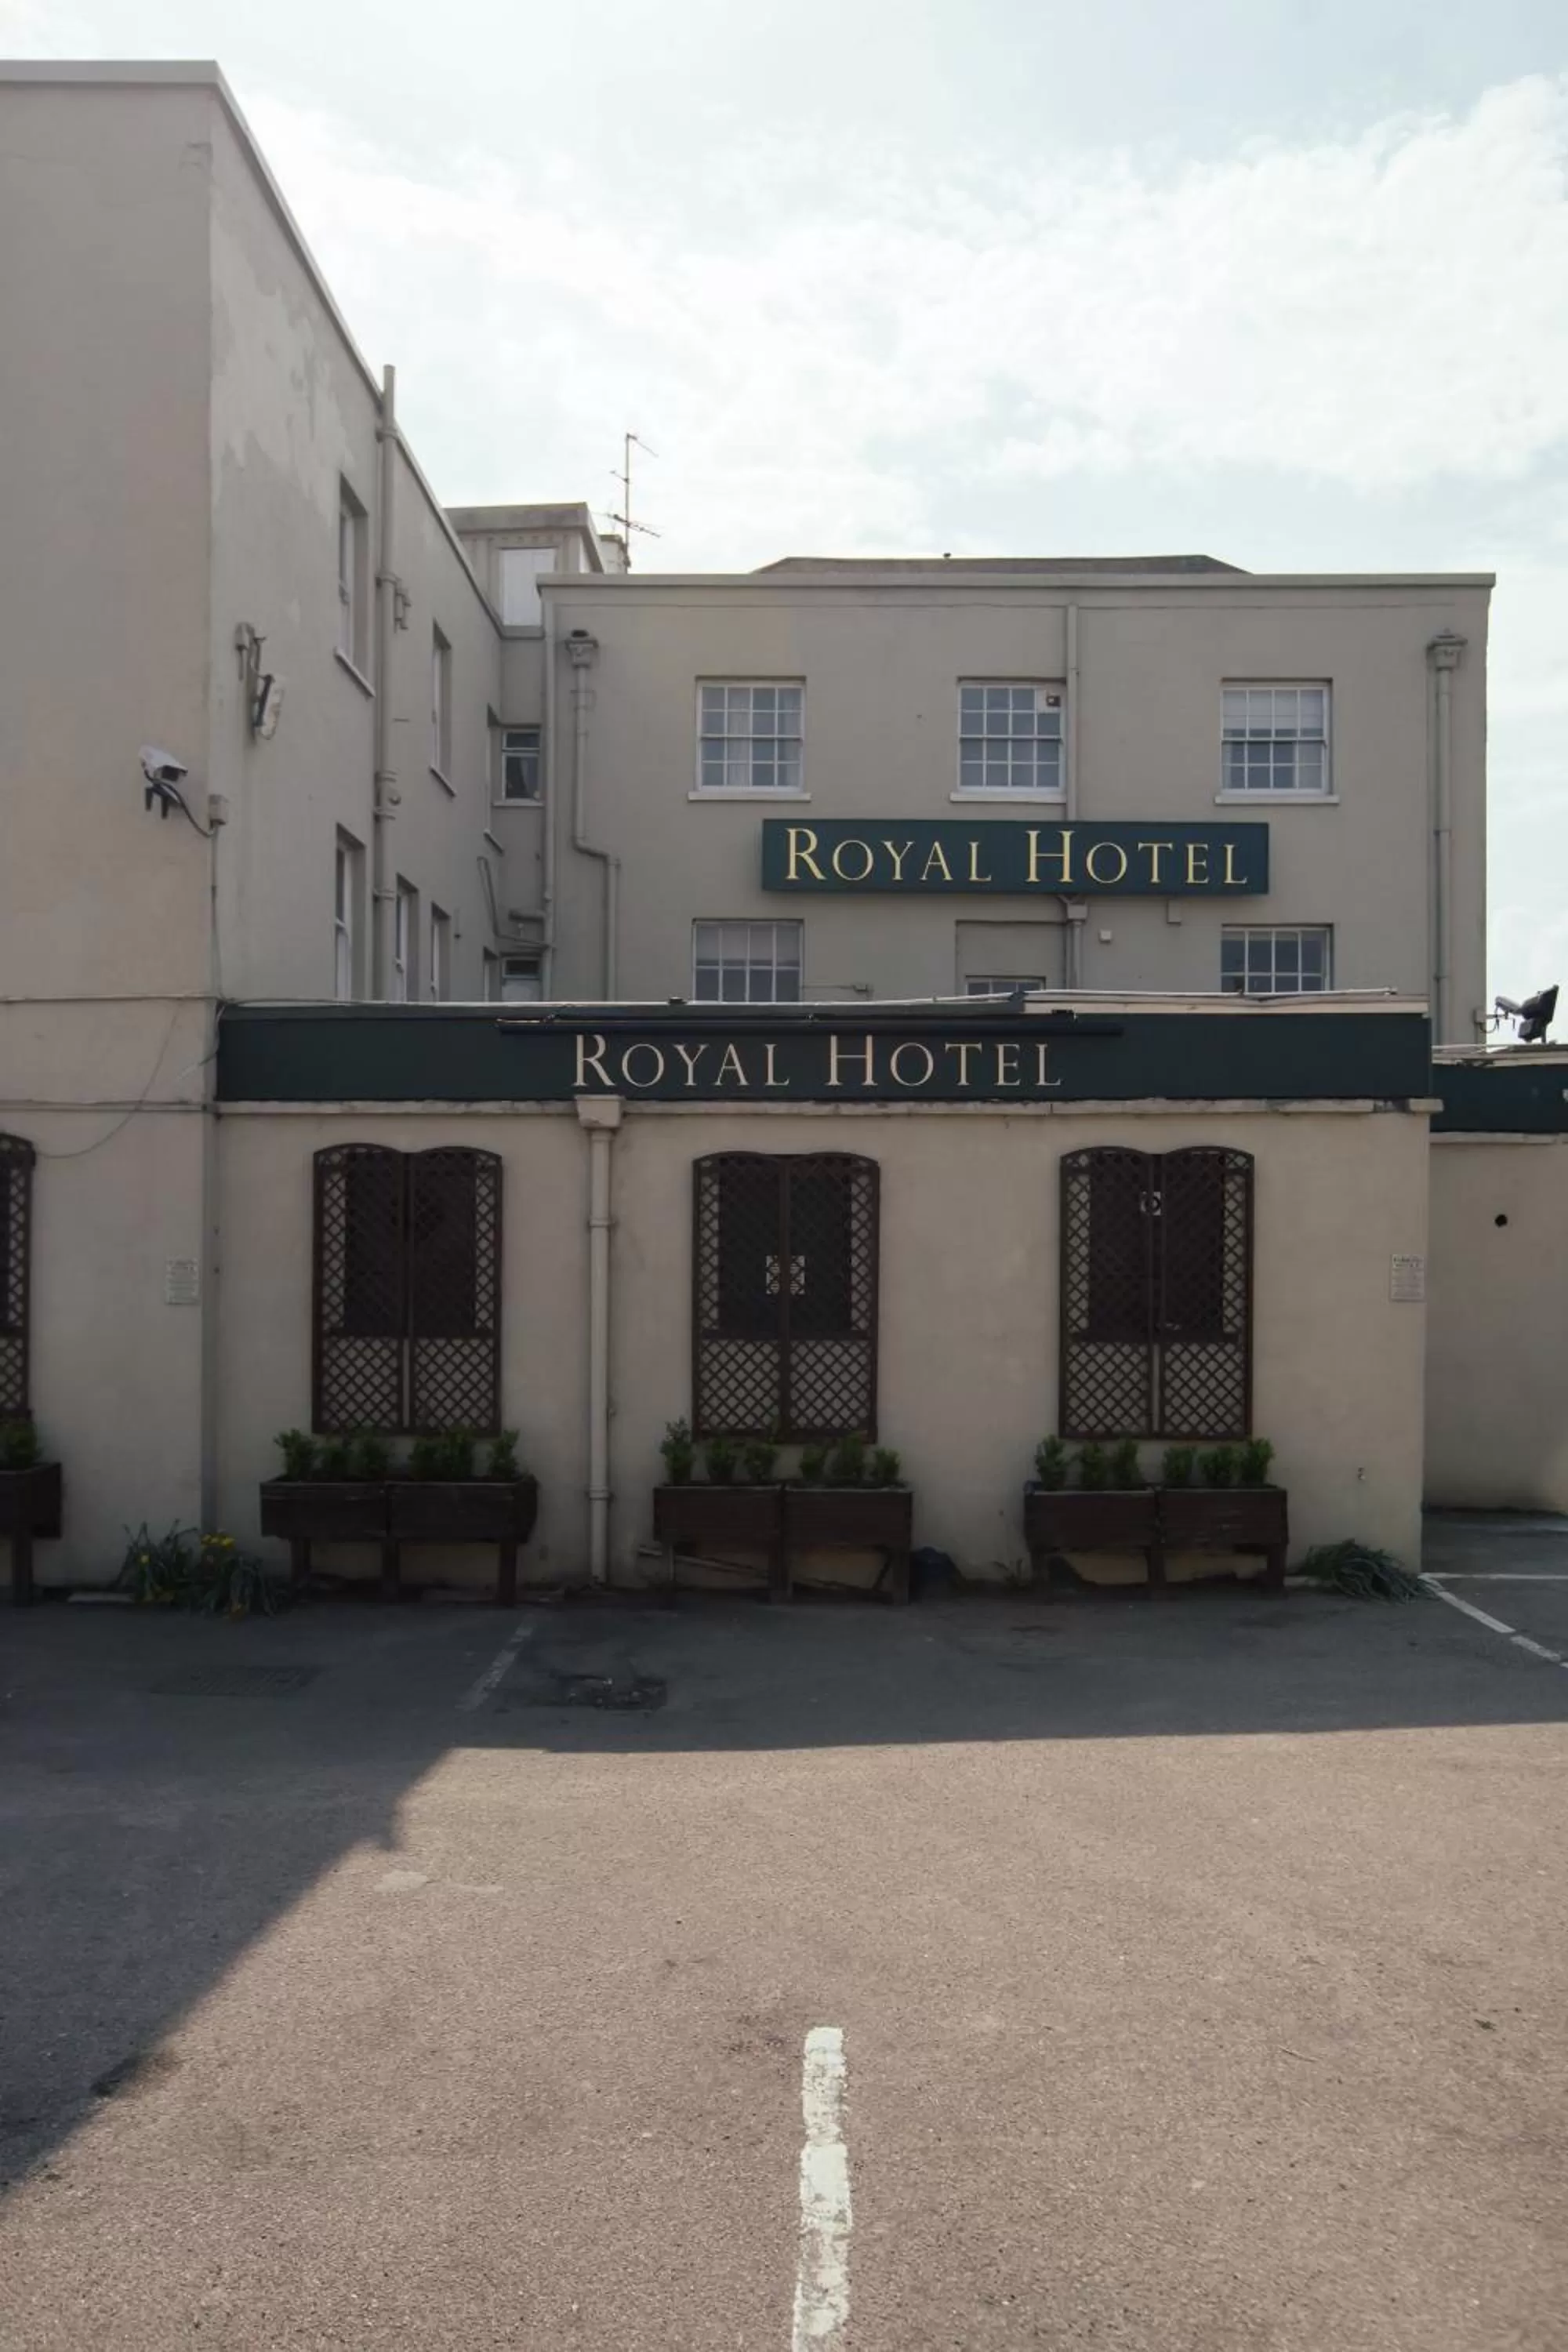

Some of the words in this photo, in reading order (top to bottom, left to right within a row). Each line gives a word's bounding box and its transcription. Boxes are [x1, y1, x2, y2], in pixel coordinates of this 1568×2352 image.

[786, 828, 993, 881] ROYAL
[1025, 830, 1247, 884] HOTEL
[572, 1034, 789, 1087] ROYAL
[826, 1035, 1062, 1087] HOTEL
